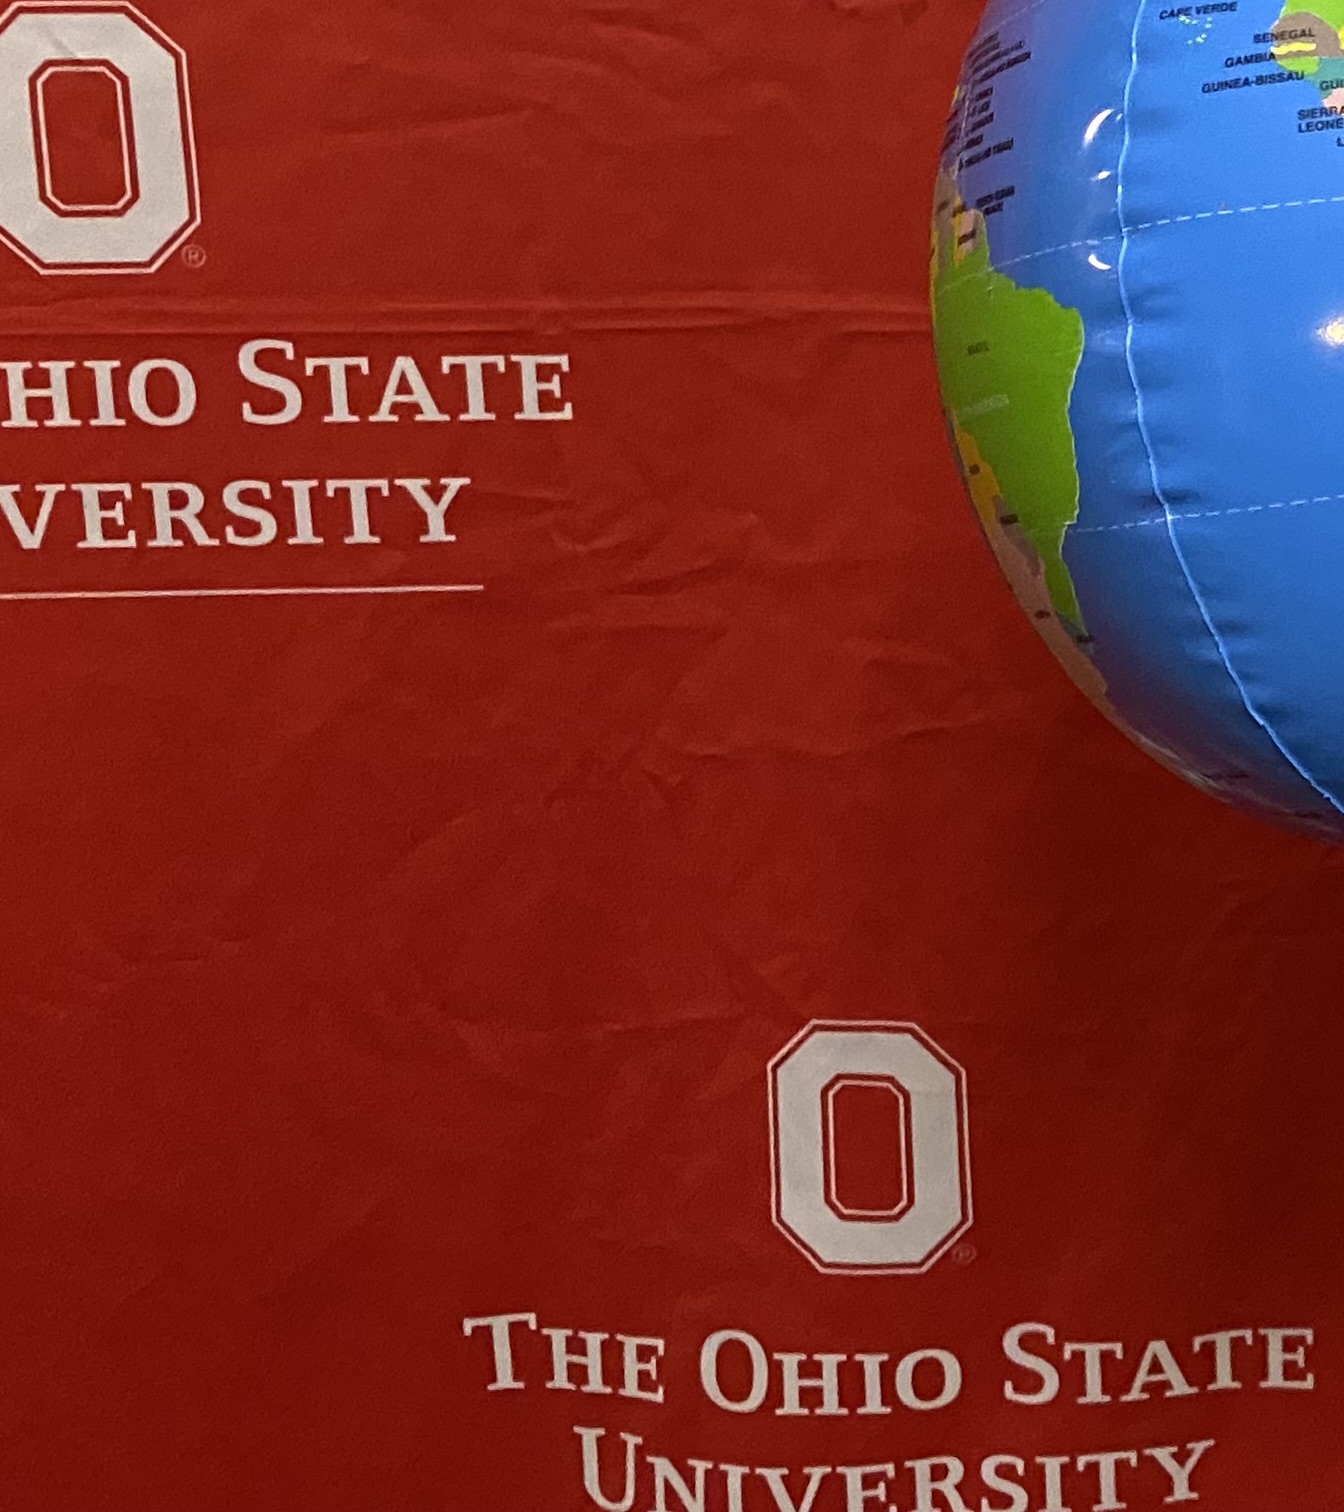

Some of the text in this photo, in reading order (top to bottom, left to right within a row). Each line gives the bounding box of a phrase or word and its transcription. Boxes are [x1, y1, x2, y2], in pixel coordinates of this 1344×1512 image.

[1159, 1, 1238, 20] CAPE VERDE
[1253, 27, 1316, 44] SENEGAL
[1224, 51, 1276, 69] GAMBIA
[1201, 71, 1305, 94] GUINEA-BISSAU
[1298, 118, 1344, 134] LEONE
[238, 339, 572, 424] STATE
[463, 1313, 1314, 1415] THE OHIO STATE
